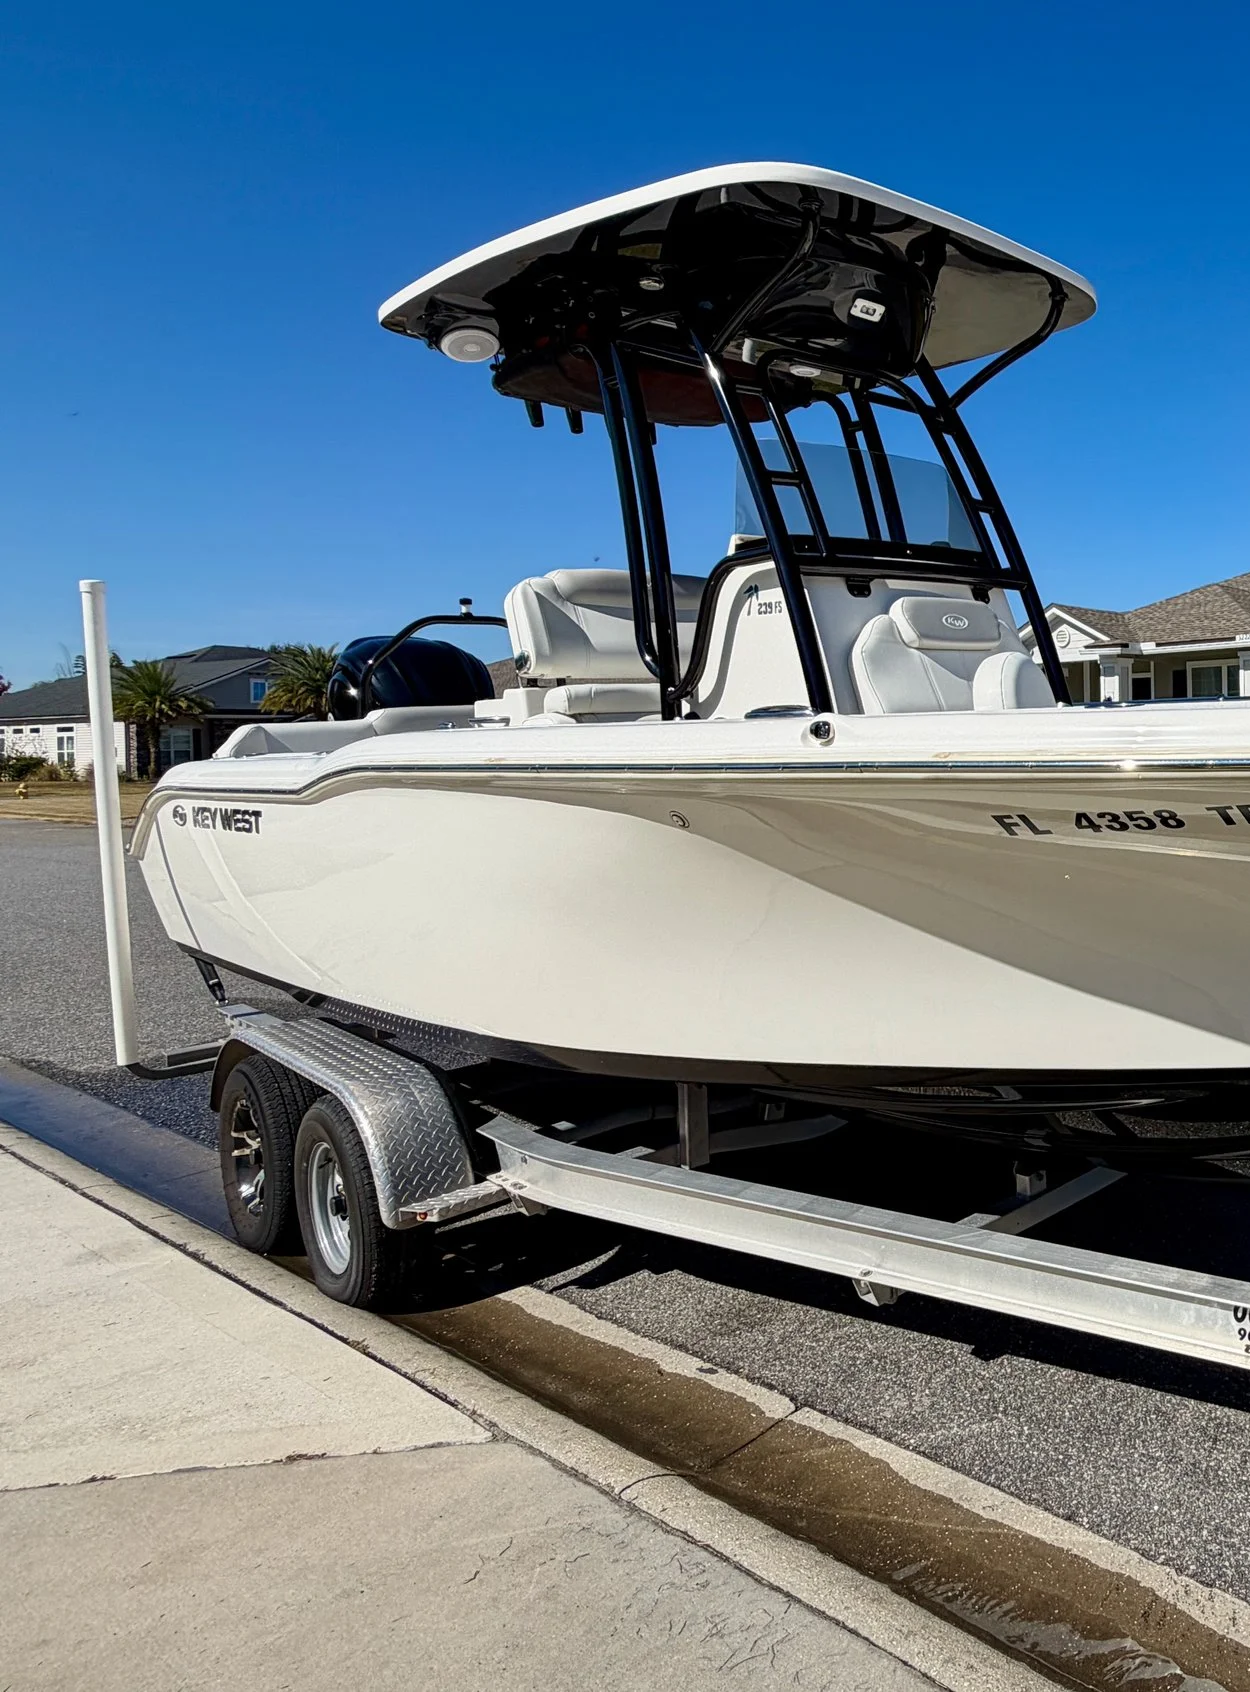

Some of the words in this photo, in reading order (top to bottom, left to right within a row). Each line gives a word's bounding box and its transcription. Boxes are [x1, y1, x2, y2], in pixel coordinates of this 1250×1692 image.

[758, 601, 773, 615] 239
[775, 600, 783, 614] FS
[192, 806, 218, 830] KEY
[219, 808, 262, 834] WEST
[990, 814, 1053, 836] FL
[1074, 809, 1186, 833] 4358
